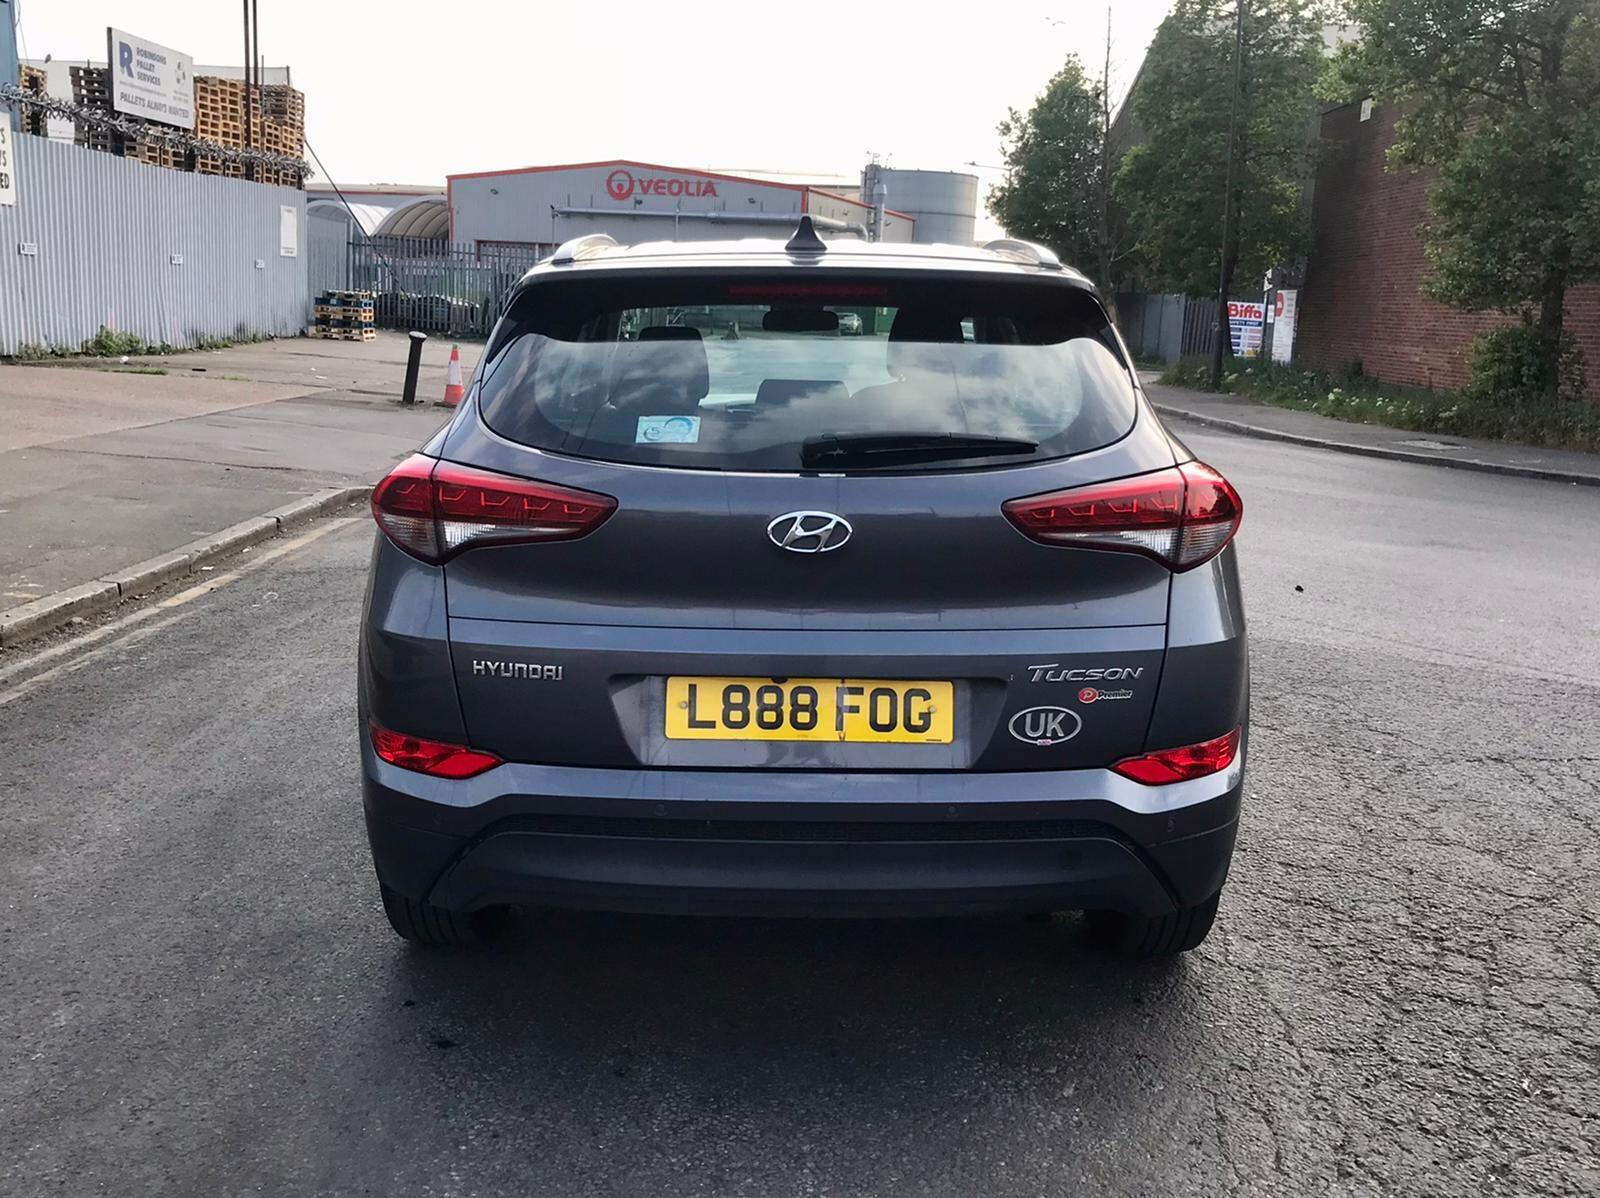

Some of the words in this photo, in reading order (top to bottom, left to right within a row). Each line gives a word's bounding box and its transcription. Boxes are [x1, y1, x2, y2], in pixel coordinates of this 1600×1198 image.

[136, 47, 167, 65] ROBINSONS
[136, 59, 155, 73] PALLET
[137, 72, 161, 86] SERVICES
[120, 92, 146, 108] PALLETS
[147, 100, 167, 114] ALWAYS
[638, 179, 718, 197] VEOLIA
[1228, 303, 1262, 319] Biffa
[472, 660, 563, 681] HYUNDAI
[1097, 689, 1133, 700] Premier
[687, 683, 818, 731] L888
[835, 686, 932, 733] FOG
[1025, 712, 1066, 738] UK
